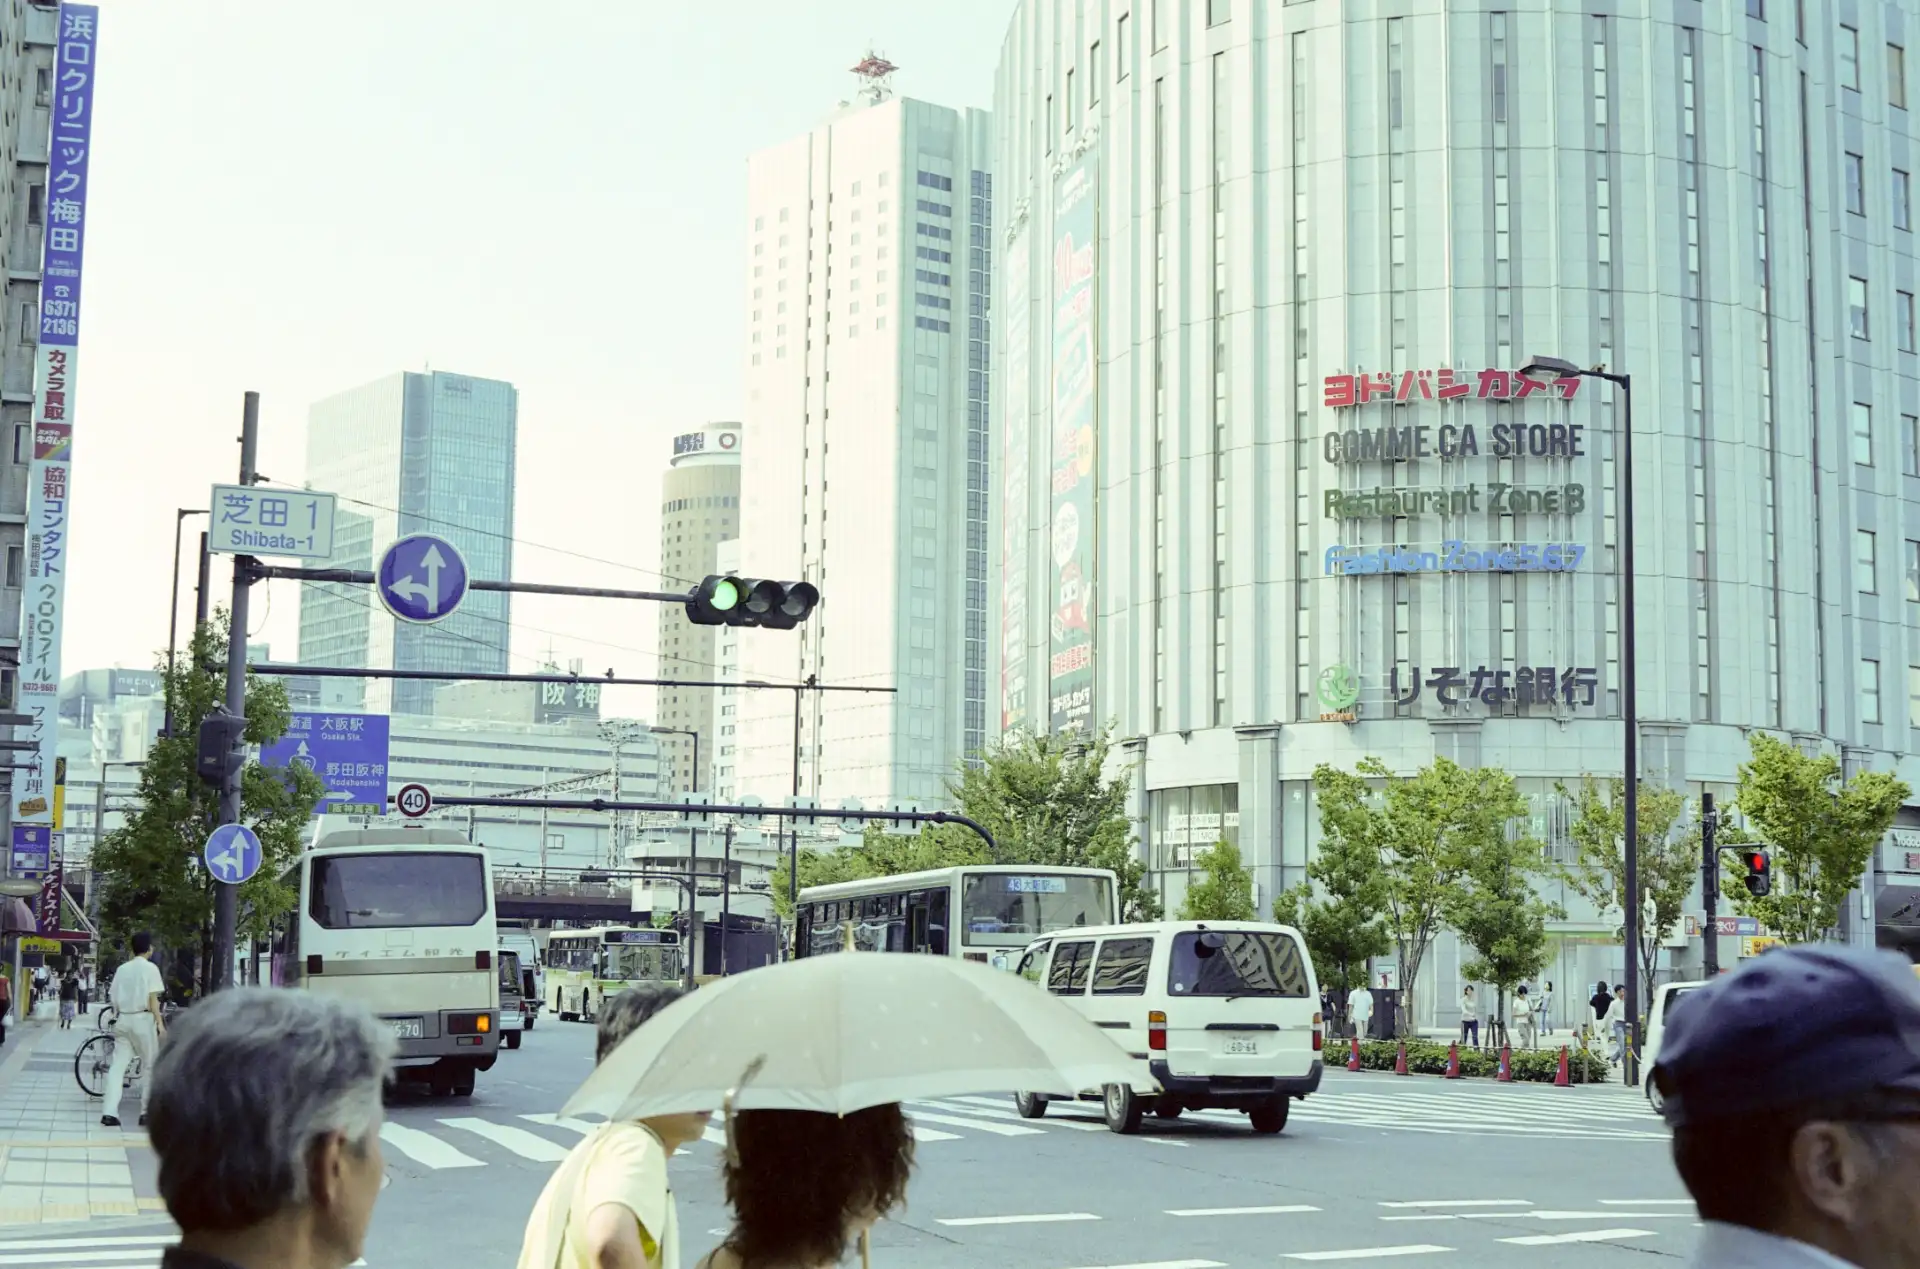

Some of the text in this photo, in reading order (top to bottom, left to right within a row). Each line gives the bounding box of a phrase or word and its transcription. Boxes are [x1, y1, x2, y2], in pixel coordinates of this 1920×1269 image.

[50, 14, 93, 252] 浜口クリニック梅田
[44, 299, 77, 317] 6371
[42, 317, 77, 336] 2136
[44, 349, 67, 420] カメラ買取
[1324, 368, 1581, 407] ヨドバシカメラ
[1492, 423, 1585, 458] STORE
[1324, 482, 1480, 519] Restaurant
[230, 529, 314, 551] Shibata-1
[541, 681, 599, 709] 阪神
[1390, 665, 1598, 706] りそな銀行
[320, 716, 365, 731] 大阪駅
[321, 732, 345, 741] Osaka
[326, 762, 385, 777] 野田阪神
[404, 793, 424, 809] 40
[1008, 879, 1021, 892] 43
[335, 948, 465, 959] ケイエム観光
[394, 1024, 420, 1037] 5-70
